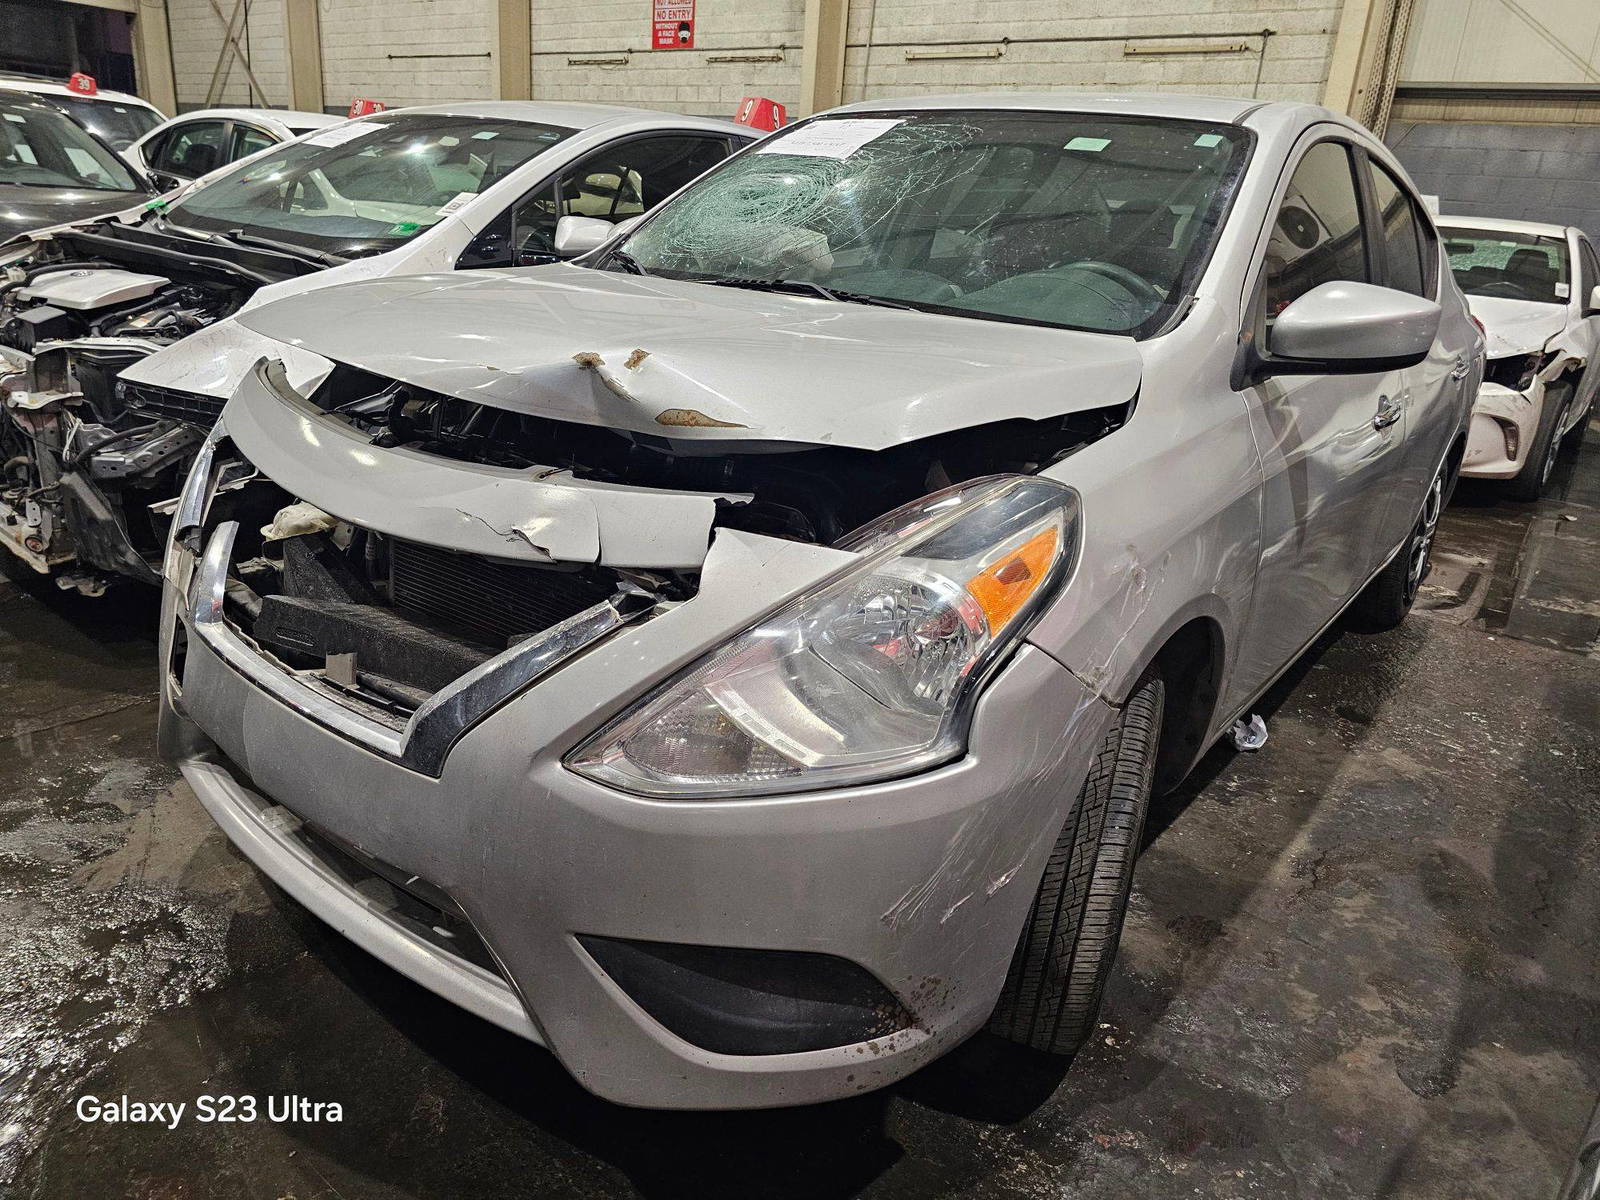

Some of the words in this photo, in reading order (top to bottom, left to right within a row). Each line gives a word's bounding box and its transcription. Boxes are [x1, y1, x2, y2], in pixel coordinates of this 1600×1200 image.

[656, 10, 666, 20] NO
[669, 9, 691, 19] ENTRY
[741, 100, 753, 121] 9
[773, 105, 779, 129] 9
